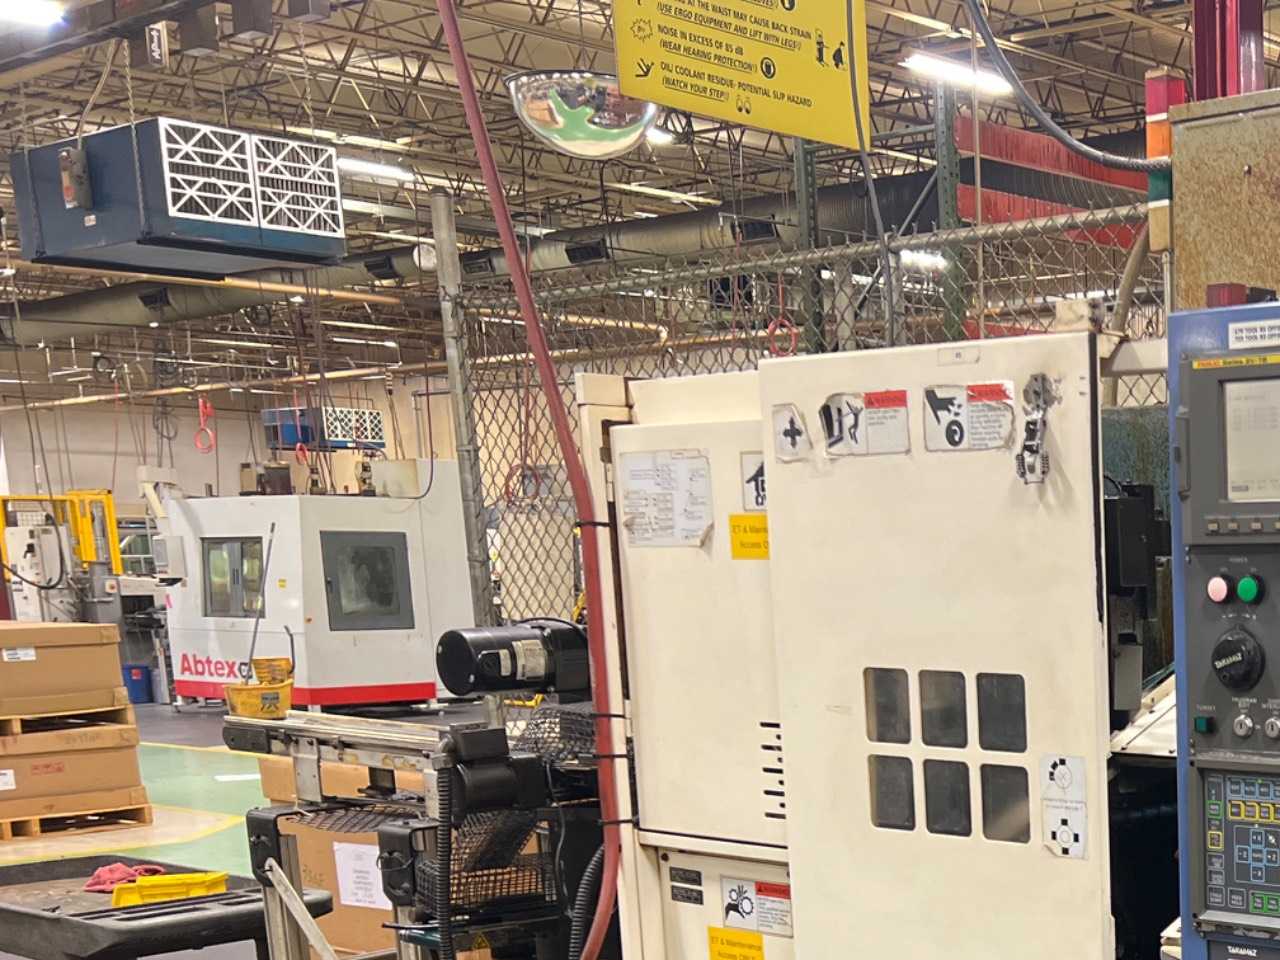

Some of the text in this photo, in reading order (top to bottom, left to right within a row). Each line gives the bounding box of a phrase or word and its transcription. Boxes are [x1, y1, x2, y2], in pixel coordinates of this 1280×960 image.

[674, 7, 693, 19] ERGO
[694, 12, 732, 30] EQUIPMENT
[733, 24, 748, 35] AND
[749, 15, 770, 29] CAUSE
[771, 21, 788, 33] BACK
[790, 27, 812, 40] STRAIN
[657, 24, 678, 38] NOISE
[688, 33, 713, 48] EXCESS
[682, 46, 712, 61] HEARING
[675, 65, 706, 80] COOLANT
[737, 81, 771, 98] POTENTIAL
[772, 89, 785, 101] SLIP
[786, 94, 812, 107] HAZARD
[690, 84, 707, 95] YOUR
